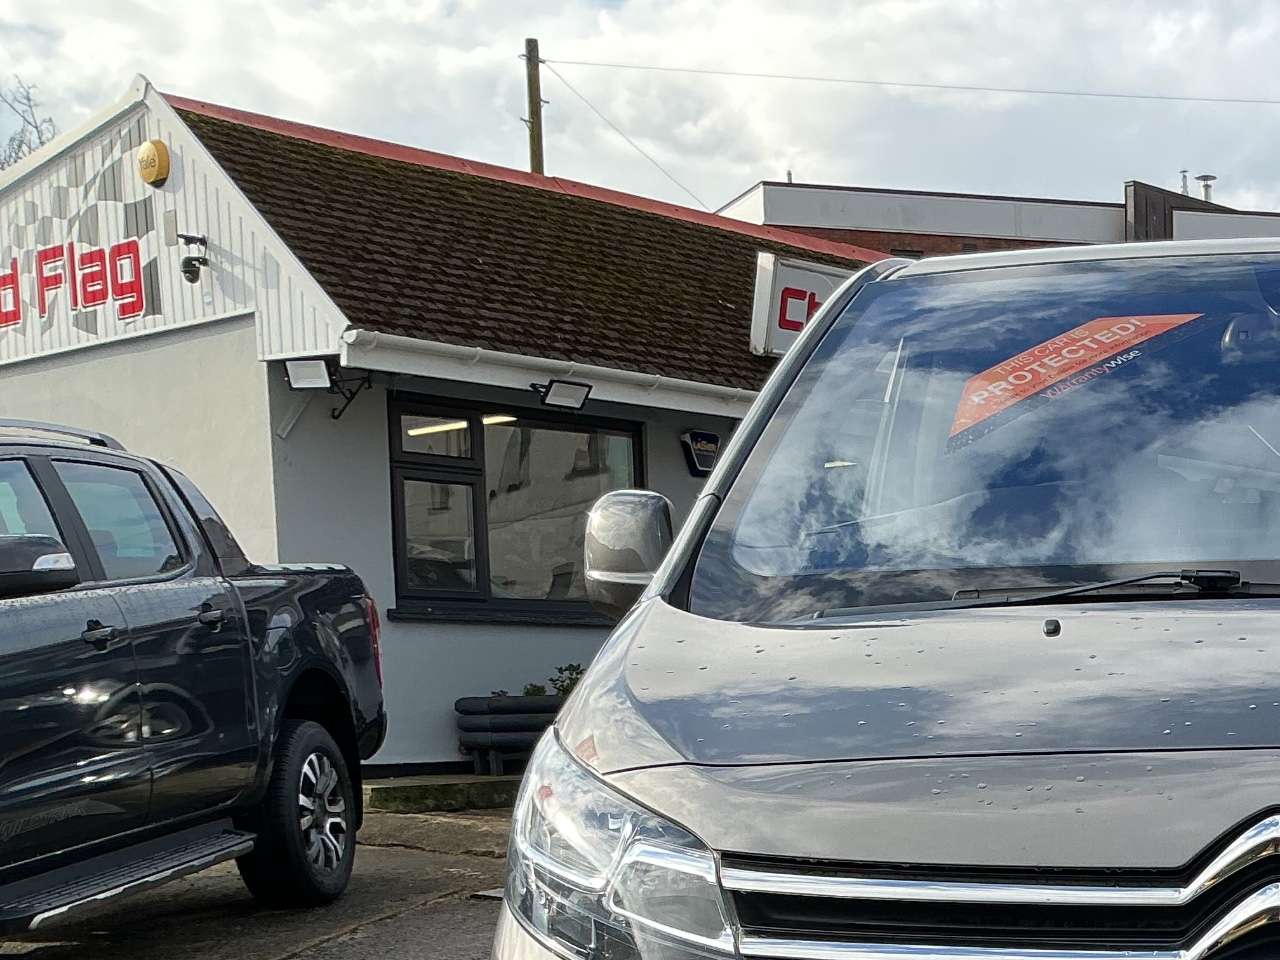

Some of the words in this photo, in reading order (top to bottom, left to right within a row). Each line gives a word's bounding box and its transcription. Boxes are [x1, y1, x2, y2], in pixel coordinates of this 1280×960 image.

[36, 239, 145, 321] Flag
[969, 318, 1147, 405] PROTECTED!
[992, 353, 1034, 377] THIS
[1035, 337, 1070, 357] CAR
[1071, 328, 1090, 342] IS
